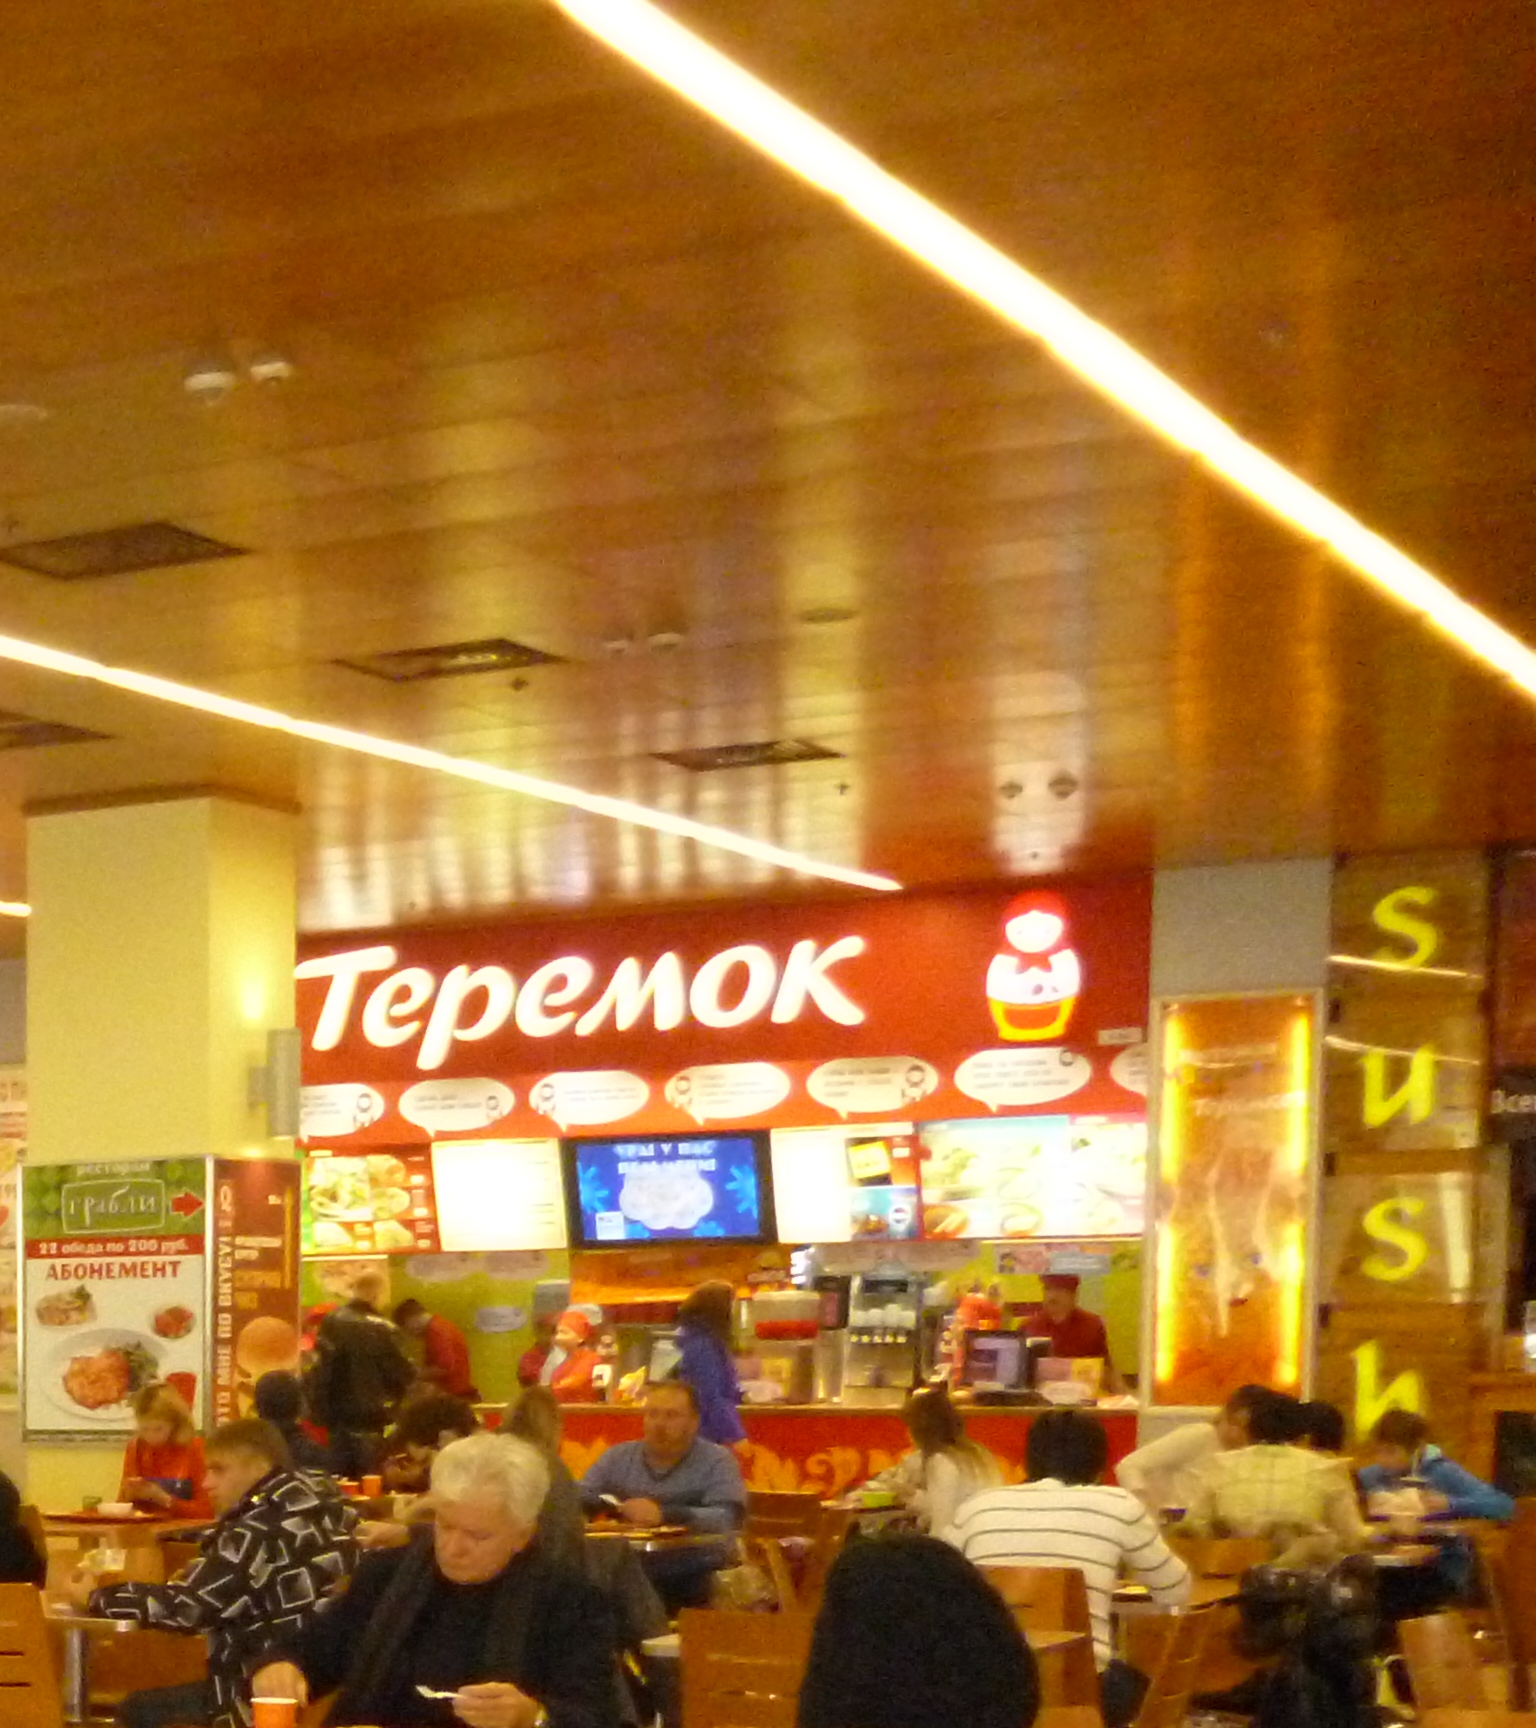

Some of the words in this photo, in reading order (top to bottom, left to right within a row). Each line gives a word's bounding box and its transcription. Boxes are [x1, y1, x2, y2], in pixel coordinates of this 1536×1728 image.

[293, 935, 866, 1070] Теремок
[106, 1242, 124, 1252] по
[127, 1238, 158, 1252] 200
[45, 1260, 182, 1281] АБОНЕМЕНТ
[217, 1235, 233, 1307] ВКУСУ!
[217, 1312, 233, 1338] ПО
[217, 1345, 232, 1386] МНЕ
